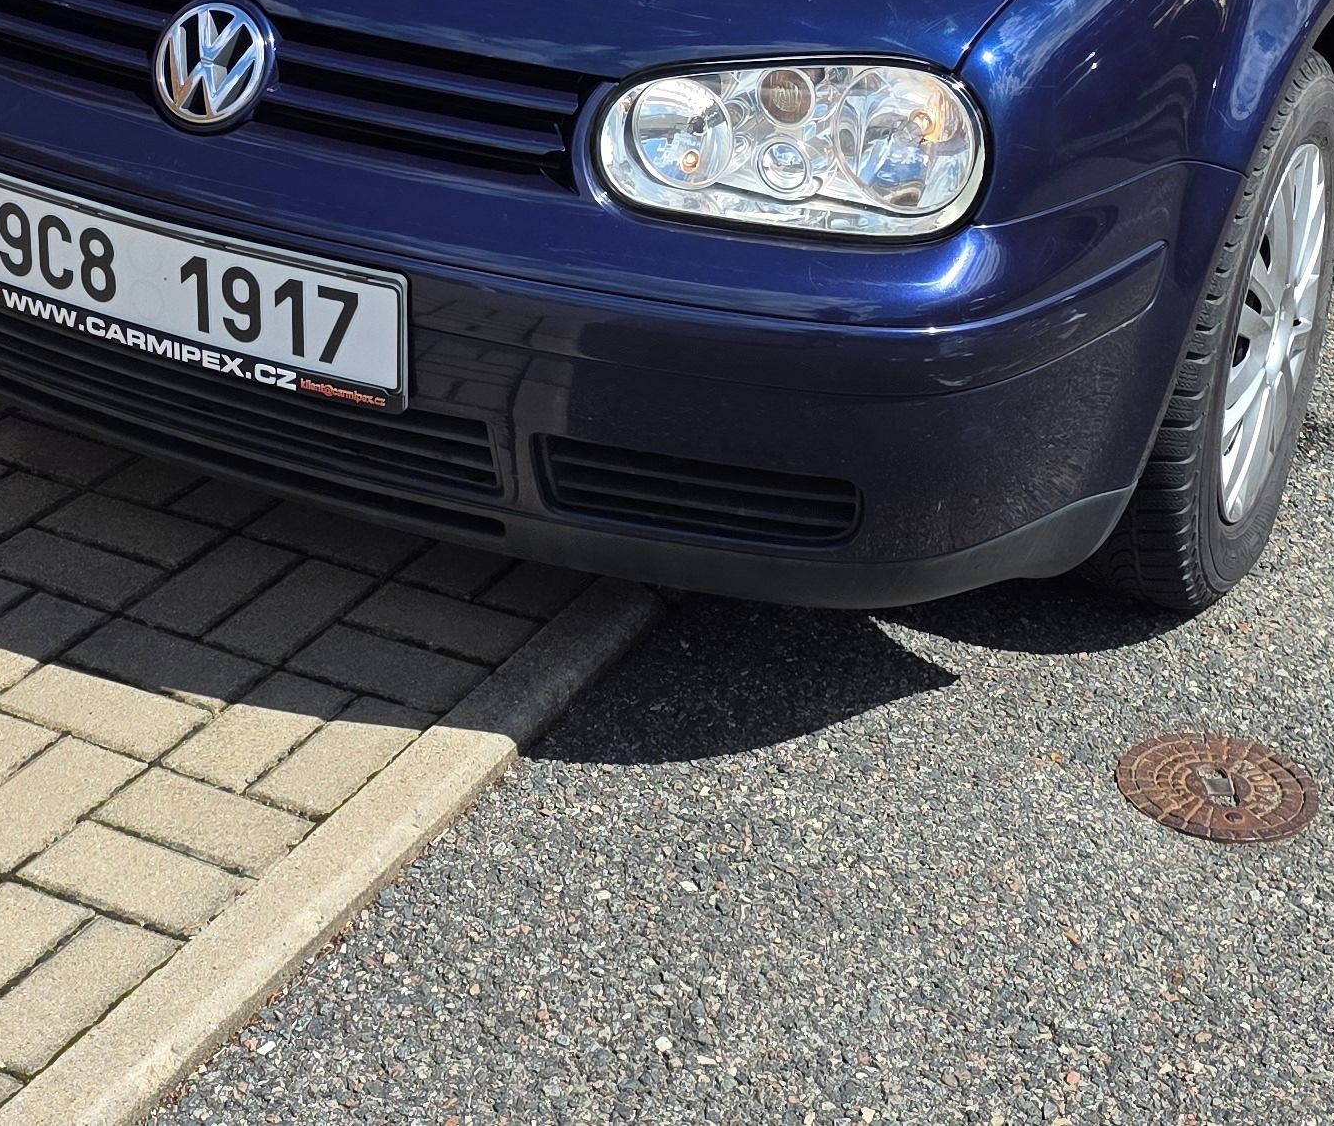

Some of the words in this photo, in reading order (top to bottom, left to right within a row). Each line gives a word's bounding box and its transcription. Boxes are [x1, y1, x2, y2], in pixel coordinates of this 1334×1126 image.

[167, 5, 260, 121] VW
[2, 289, 297, 391] WWW.CARMIPEX.CZ
[180, 256, 359, 364] 1917
